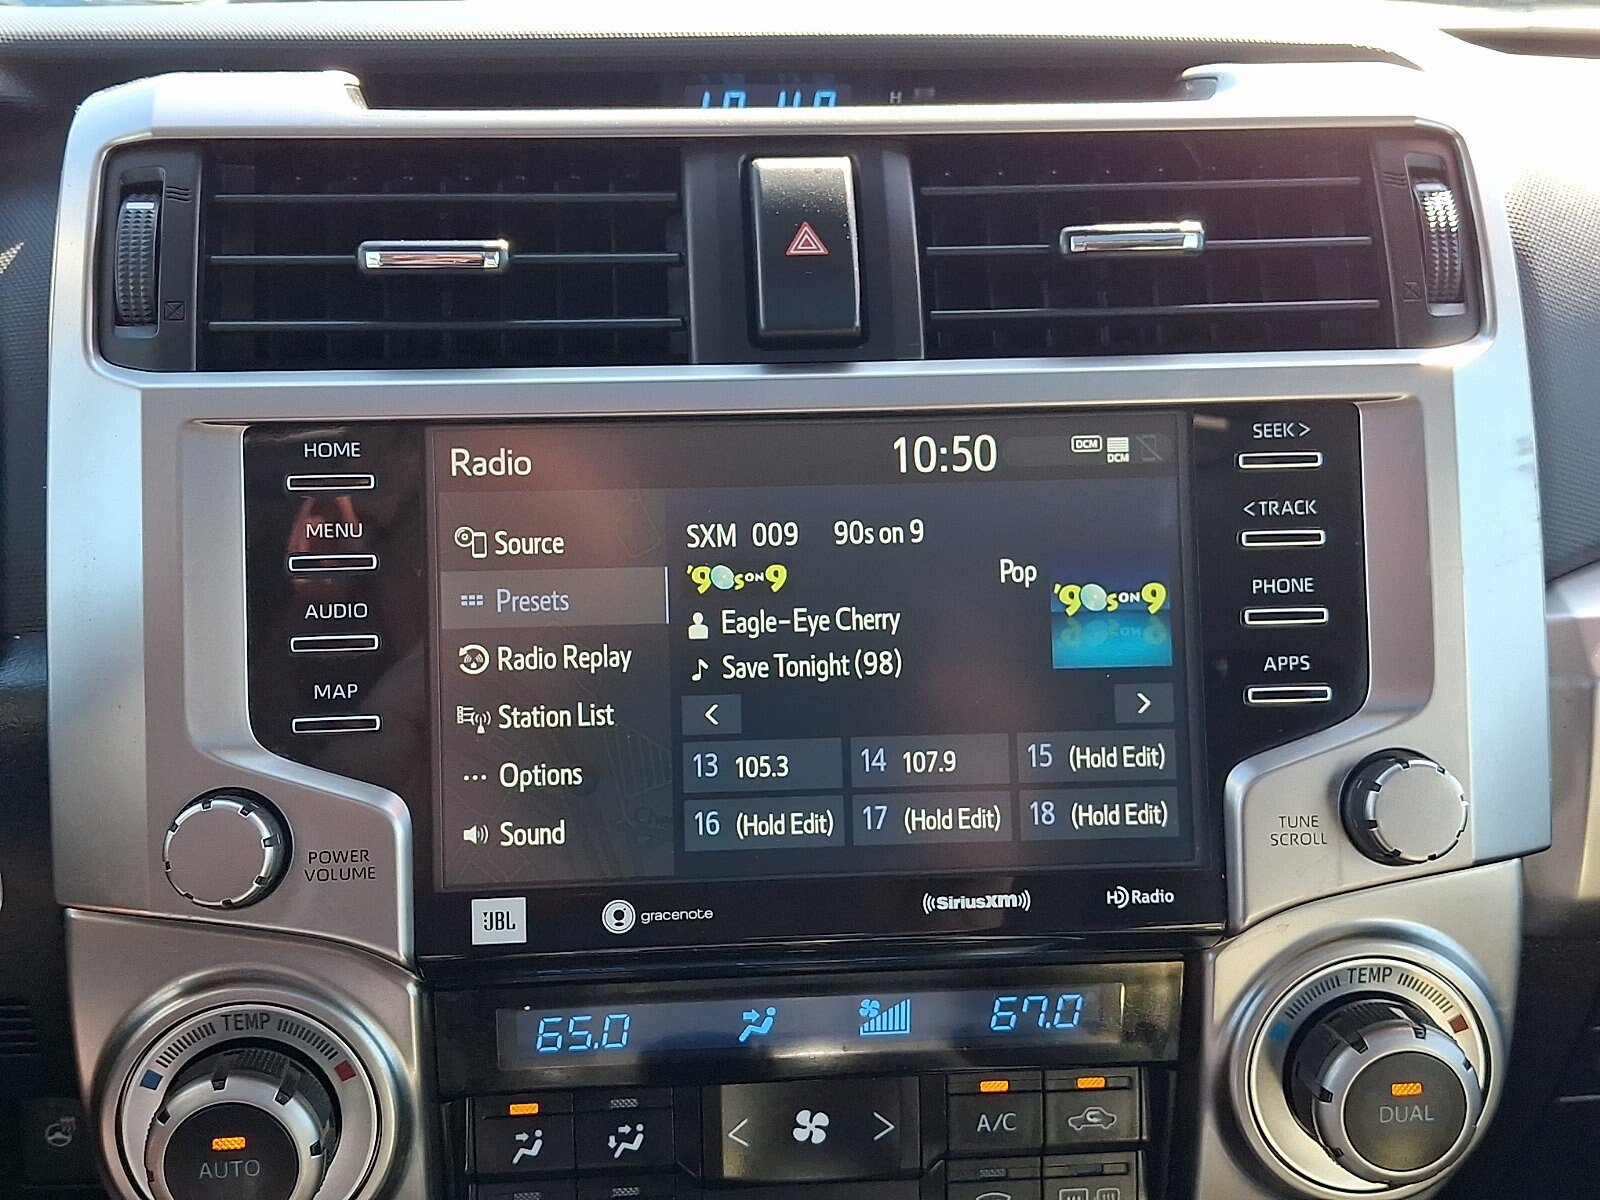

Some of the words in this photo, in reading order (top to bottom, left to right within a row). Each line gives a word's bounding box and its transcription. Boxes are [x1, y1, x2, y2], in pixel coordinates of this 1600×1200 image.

[1252, 423, 1294, 439] SEEK
[304, 442, 361, 458] HOME
[893, 434, 998, 474] 10:50
[1075, 439, 1099, 449] DCM
[450, 448, 533, 477] Radio
[1107, 453, 1130, 463] DCM
[1259, 500, 1317, 516] TRACK
[305, 523, 363, 539] MENU
[686, 523, 738, 549] SXM
[751, 521, 799, 548] 009
[834, 520, 874, 546] 90s
[879, 526, 905, 544] on
[910, 518, 925, 543] 9
[494, 529, 565, 556] Source
[1000, 559, 1038, 588] Pop
[1252, 578, 1314, 594] PHONE
[305, 603, 368, 619] AUDIO
[496, 587, 570, 613] Presets
[721, 606, 831, 638] Eagle-Eye
[835, 606, 901, 636] Cherry
[497, 646, 559, 672] Radio
[563, 644, 633, 674] Replay
[722, 654, 770, 681] Save
[773, 651, 850, 683] Tonight
[854, 647, 903, 680] (98)
[1264, 656, 1311, 671] APPS
[314, 683, 359, 699] MAP
[498, 704, 573, 730] Station
[577, 702, 615, 728] List
[693, 752, 719, 778] 13
[735, 755, 790, 780] 105.3
[861, 747, 887, 773] 14
[902, 750, 957, 774] 107.9
[1028, 742, 1053, 768] 15
[1069, 746, 1119, 772] (Hold
[1123, 742, 1166, 769] Edit)
[499, 761, 583, 793] Options
[694, 810, 721, 837] 16
[736, 811, 787, 840] (Hold
[790, 810, 835, 836] Edit)
[863, 806, 888, 832] 17
[904, 806, 955, 834] (Hold
[958, 804, 1002, 831] Edit)
[1030, 800, 1056, 827] 18
[1071, 802, 1121, 830] (Hold
[1124, 799, 1168, 828] Edit)
[1279, 815, 1318, 829] TUNE
[500, 820, 566, 847] Sound
[1270, 832, 1328, 847] SCROLL
[308, 849, 370, 865] POWER
[304, 866, 377, 882] VOLUME
[1131, 888, 1175, 905] Radio
[483, 910, 517, 932] JBL
[640, 907, 714, 925] gracenote
[1347, 967, 1393, 984] TEMP
[219, 1013, 271, 1031] TEMP
[990, 993, 1084, 1032] 67.0
[536, 1013, 631, 1053] 65.0
[976, 1112, 1017, 1132] A/C
[1379, 1104, 1434, 1123] DUAL
[199, 1159, 261, 1179] AUTO
